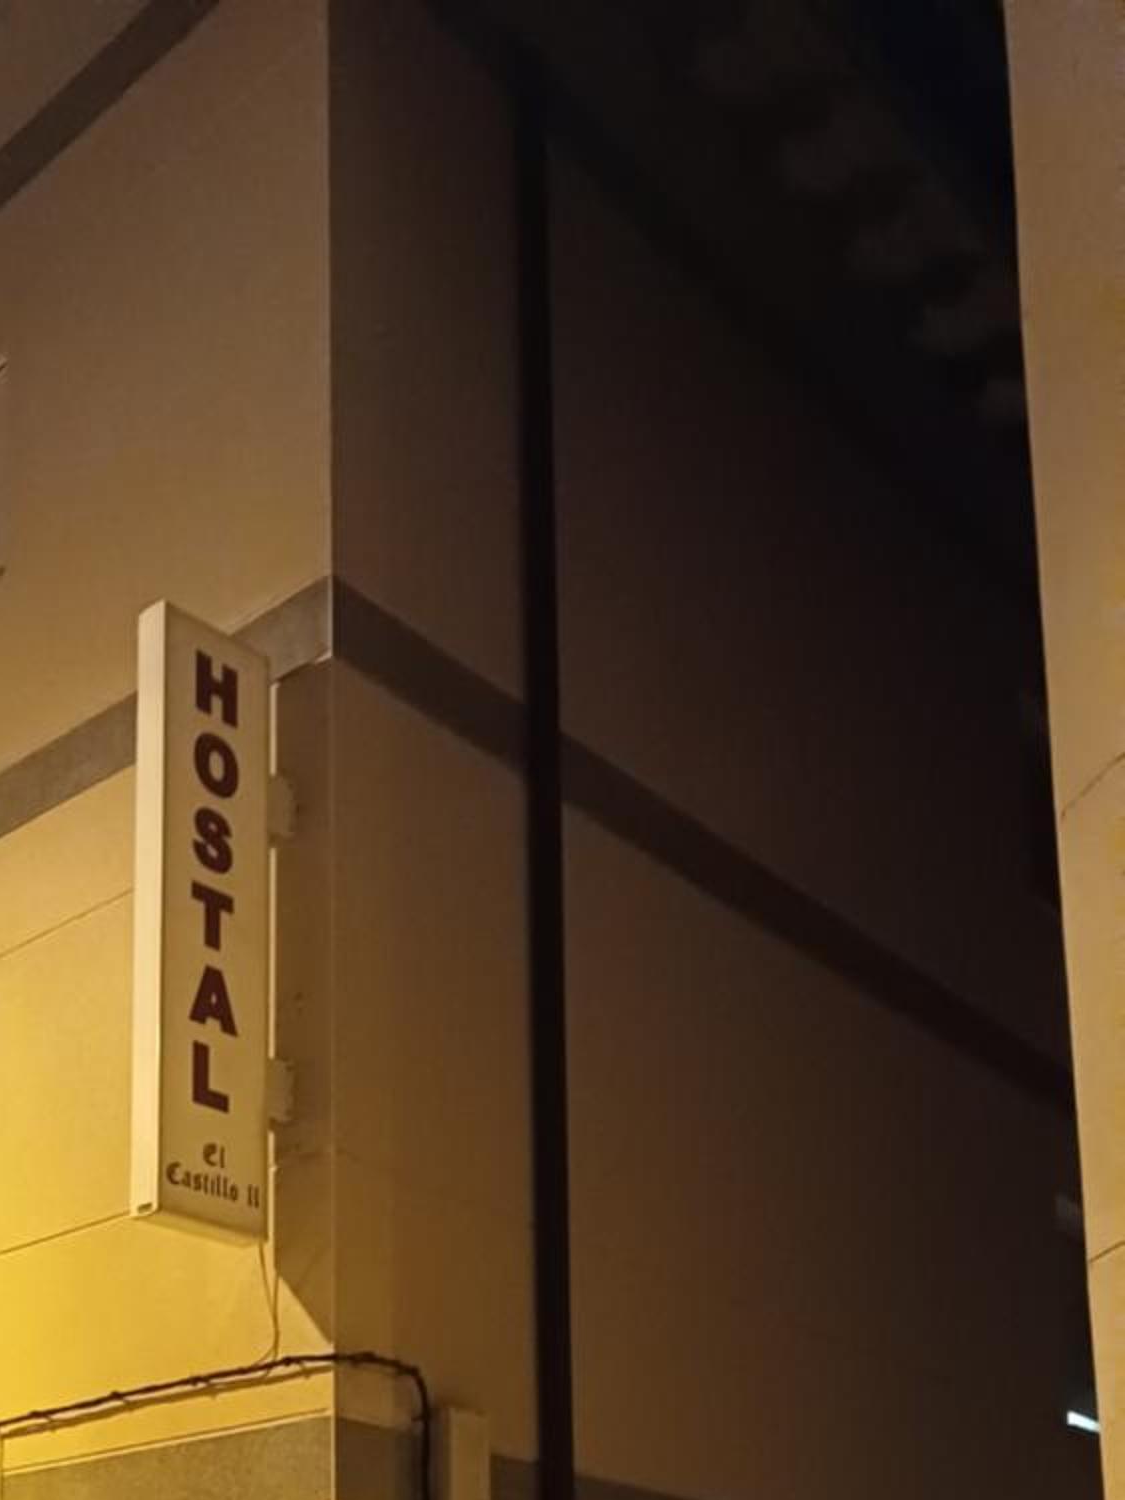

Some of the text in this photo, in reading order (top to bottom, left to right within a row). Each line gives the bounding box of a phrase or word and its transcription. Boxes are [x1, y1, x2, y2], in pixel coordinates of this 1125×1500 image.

[189, 649, 239, 1114] HOSTAL
[202, 1143, 225, 1169] El
[166, 1161, 239, 1203] Castillo
